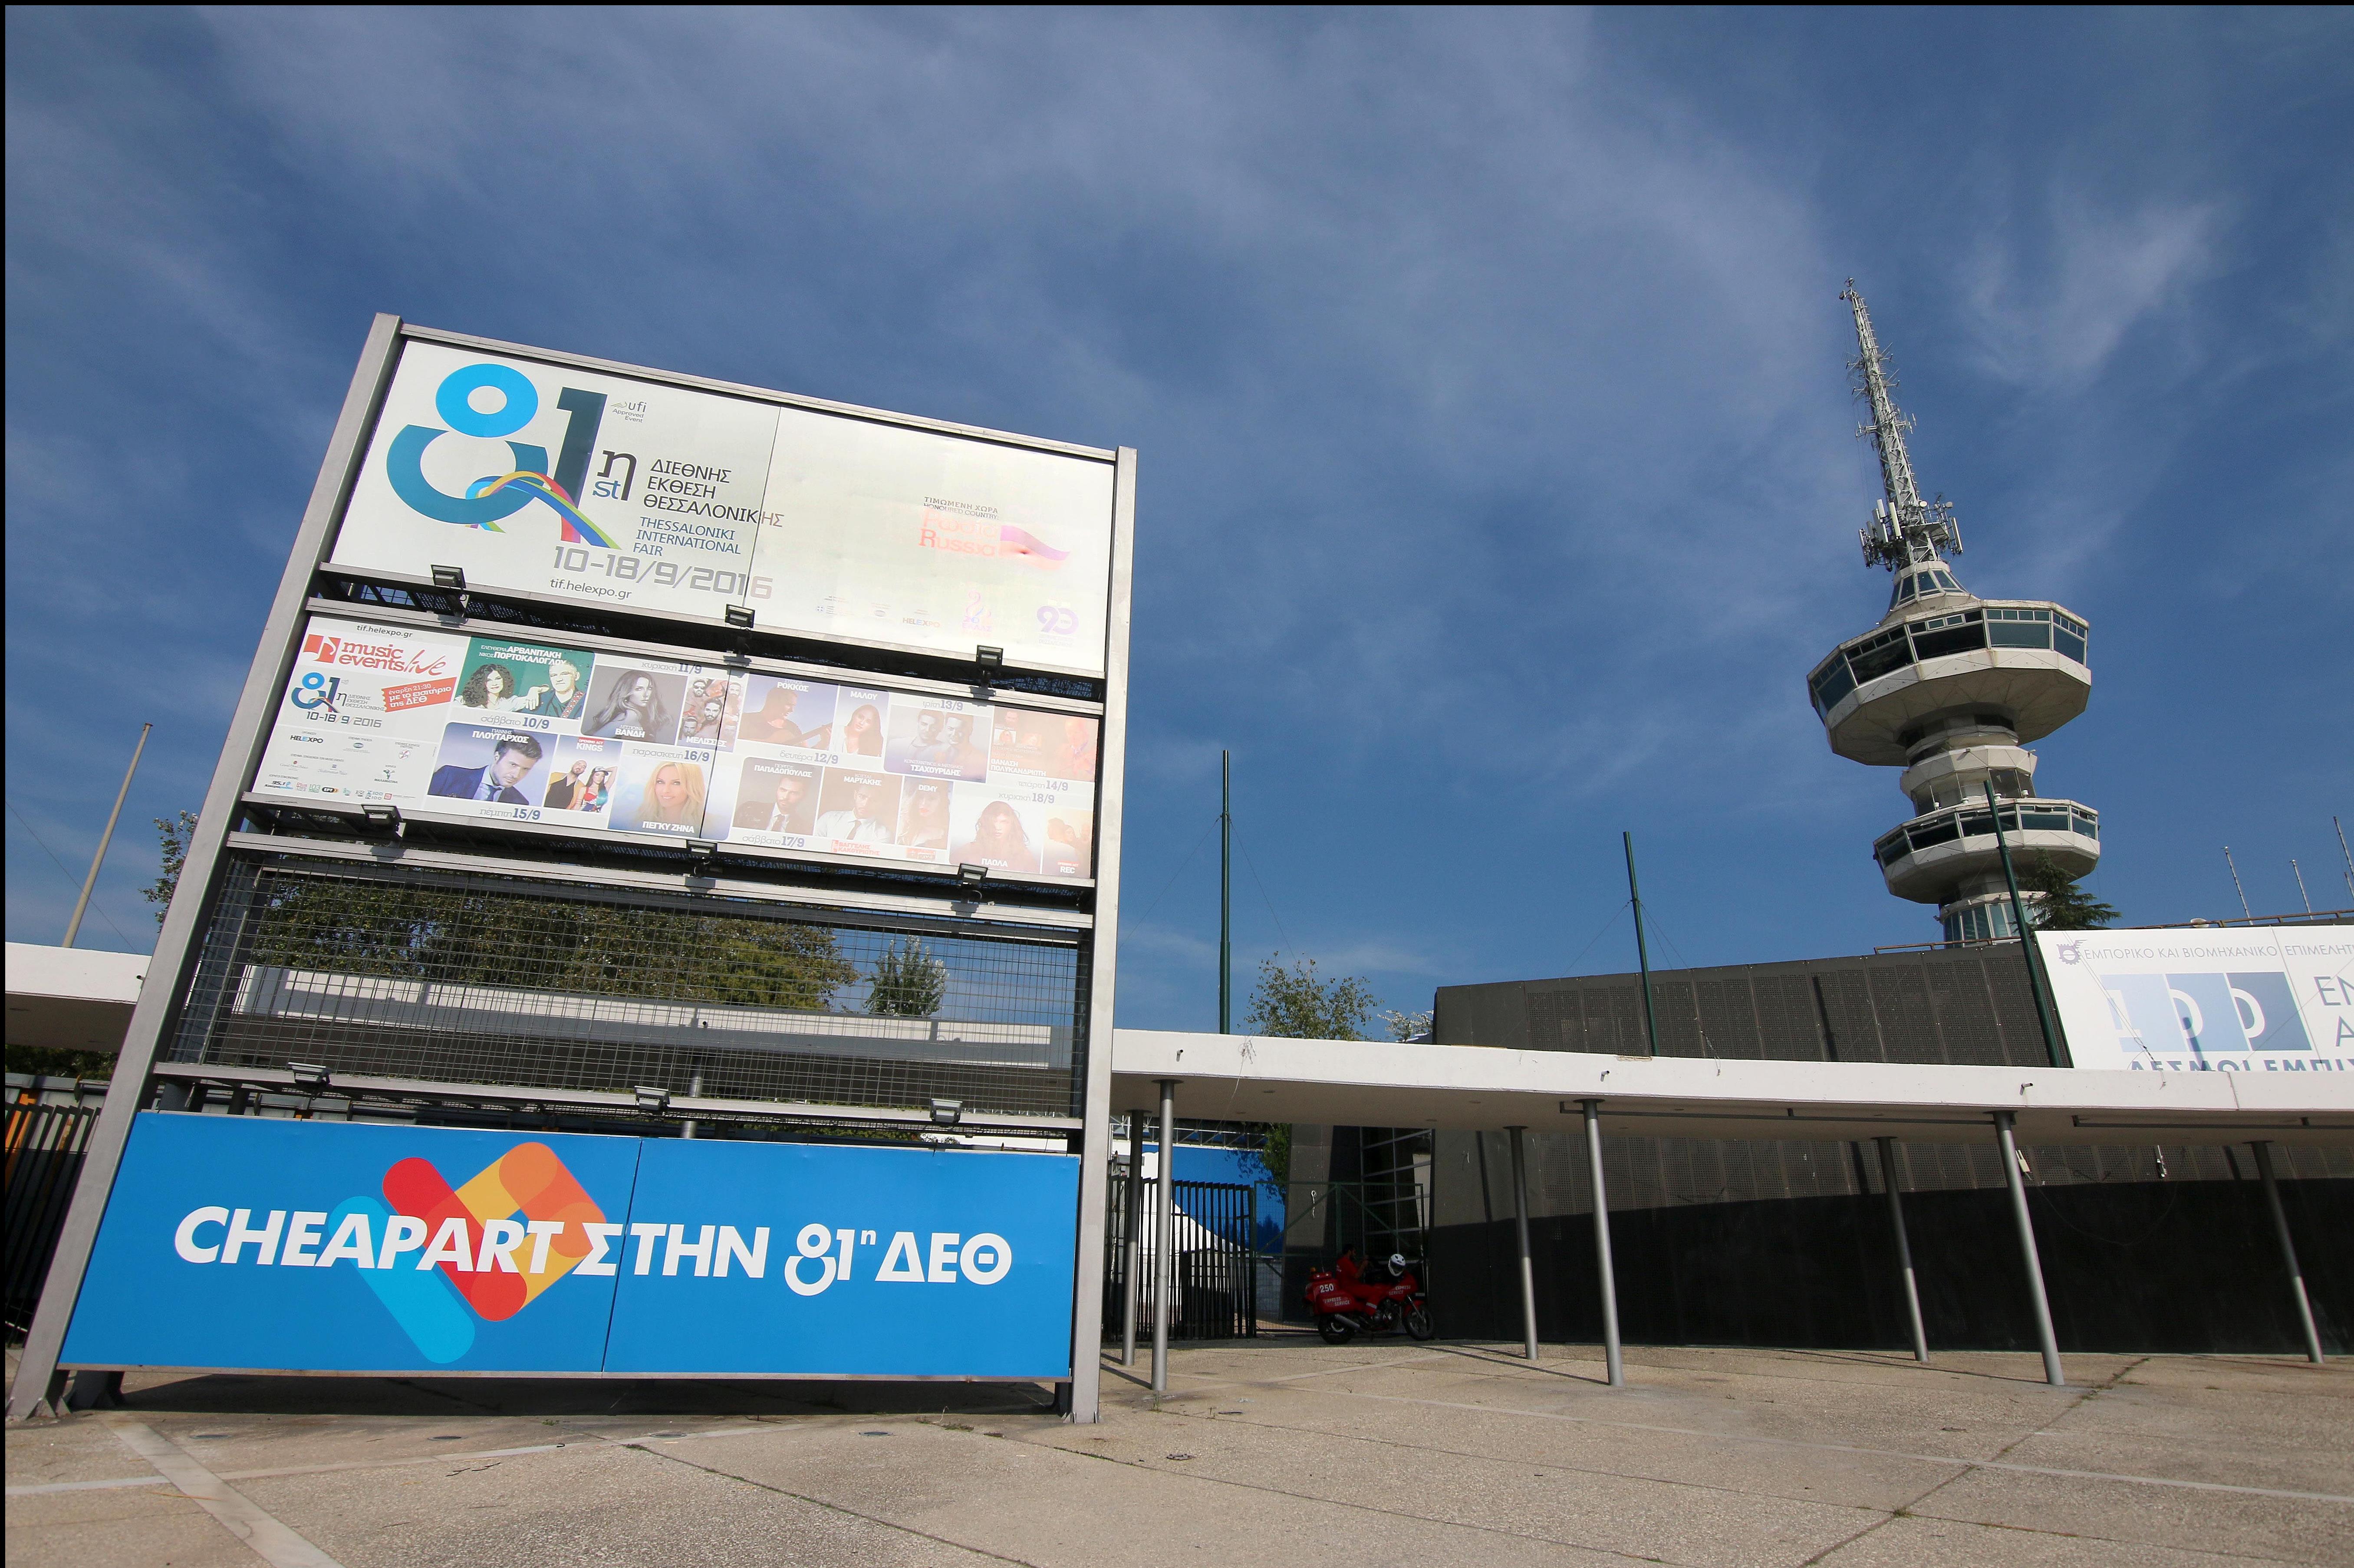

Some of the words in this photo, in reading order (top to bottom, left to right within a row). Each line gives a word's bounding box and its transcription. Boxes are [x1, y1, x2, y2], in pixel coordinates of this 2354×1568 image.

[612, 408, 644, 418] Approved
[628, 401, 647, 412] ufi
[651, 459, 732, 483] ΔΙΕΘΝΗΣ
[648, 476, 716, 499] ΕΚΘΕΣΗ
[644, 494, 784, 527] ΘΕΣΣΑΛΟΝΙΚΗΣ
[923, 496, 973, 510] ΤΙΜΩΜΕΝΗ
[975, 504, 998, 514] ΧΩΡΑ
[923, 503, 964, 514] HONOURED
[640, 517, 736, 540] THESSALONIKI
[636, 529, 741, 554] INTERNATIONAL
[918, 528, 996, 557] Russia
[633, 542, 663, 556] FAIR
[553, 546, 773, 599] 10-18/9/2016
[550, 579, 632, 600] tif.helexpo.gr
[902, 617, 941, 628] HELEXPO
[356, 625, 413, 638] tif.helexpo.gr
[342, 641, 404, 659] music
[506, 646, 562, 659] ΑΡΒΑΝΙΤΑΚΗ
[339, 654, 405, 672] events
[404, 650, 446, 675] live
[494, 651, 567, 665] ΠΟΡΤΟΚΑΛΟΓΛΟΥ
[678, 663, 702, 674] 11/9
[777, 682, 809, 692] ΡΟΚΚΟΣ
[406, 696, 427, 705] ΔΕΘ
[850, 691, 877, 700] ΜΑΛΟΥ
[940, 699, 964, 711] 13/9
[306, 711, 382, 728] 10-18/9/2016
[481, 715, 521, 726] σάββατο
[522, 717, 550, 729] 10/9
[290, 735, 323, 743] HELEXPO
[472, 730, 530, 743] ΠΛΟΥΤΑΡΧΟΣ
[615, 728, 645, 738] ΒΑΝΔΗ
[576, 742, 603, 752] KINGS
[632, 748, 684, 759] παρασκευή
[684, 750, 710, 762] 16/9
[780, 750, 813, 762] δευτέρα
[814, 752, 839, 764] 12/9
[754, 765, 813, 778] ΠΑΠΑΔΟΠΟΥΛΟΣ
[911, 764, 961, 776] ΤΣΑΧΟΥΡΙΔΗΣ
[844, 776, 882, 786] ΜΑΡΤΑΚΗΣ
[1046, 780, 1069, 791] 14/9
[1031, 792, 1055, 803] 18/9
[512, 808, 541, 820] 15/9
[642, 821, 671, 830] ΠΕΓΚΥ
[671, 824, 695, 833] ΖΗΝΑ
[742, 835, 780, 846] σάββατο
[781, 836, 805, 848] 17/9
[981, 858, 1008, 867] ΠΑΟΛΑ
[1060, 866, 1075, 874] REC
[2084, 948, 2154, 960] ΕΜΠΟΡΙΚΟ
[2157, 948, 2179, 958] ΚΑΙ
[2183, 946, 2277, 957] ΒΙΟΜΗΧΑΝΙΚΟ
[2264, 1058, 2354, 1071] ΕΜΠΙ
[174, 1205, 564, 1274] CHEAPART
[572, 1223, 770, 1279] ΣΤΗΝ
[875, 1231, 1012, 1286] ΔΕΘ
[1320, 1283, 1334, 1293] 250
